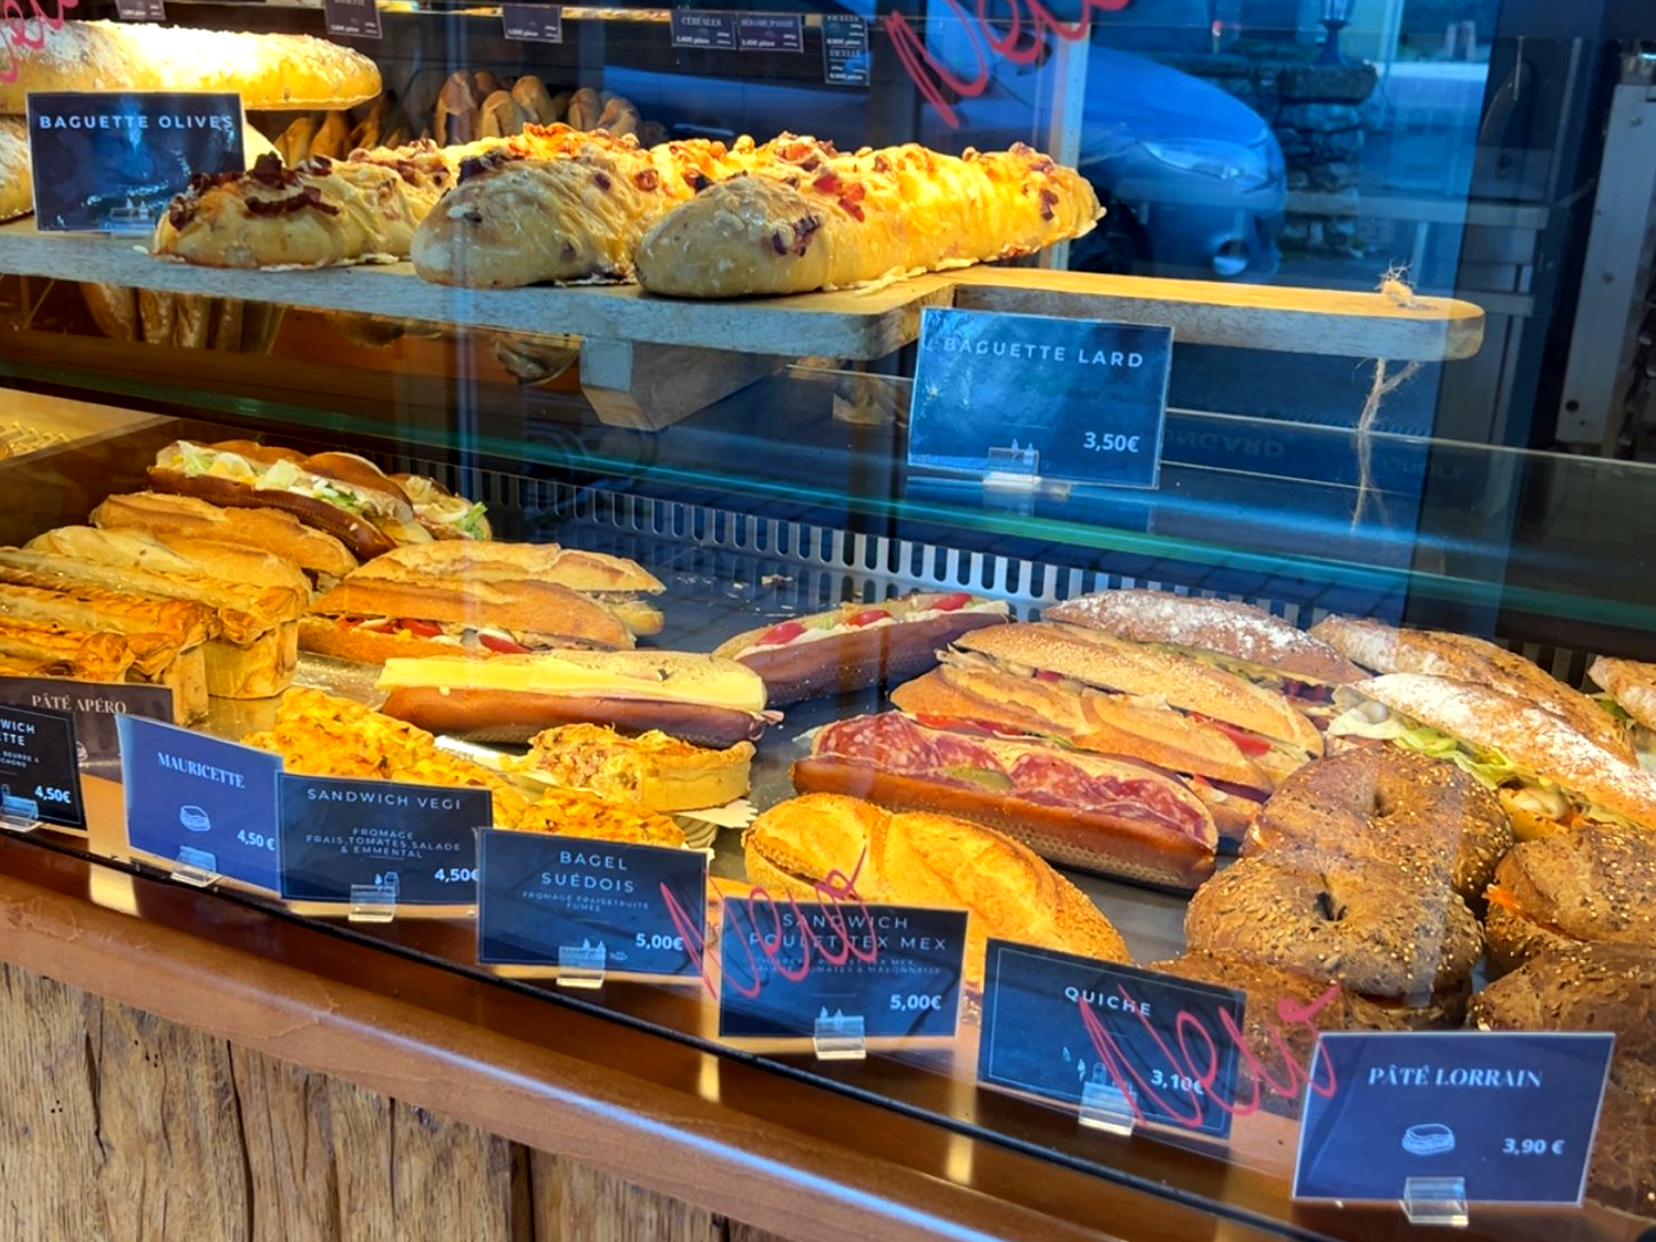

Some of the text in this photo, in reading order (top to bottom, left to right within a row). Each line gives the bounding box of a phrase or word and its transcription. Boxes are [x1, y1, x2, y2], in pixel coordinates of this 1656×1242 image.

[39, 114, 234, 129] BAGUETTE OLIVES
[943, 337, 1144, 368] BAGUETTE LARD
[1083, 431, 1140, 452] 3,50€
[31, 692, 127, 714] PÂTÉ APÉRO
[0, 731, 25, 746] TTE
[157, 751, 246, 789] MAURICETTE
[34, 785, 71, 804] 4,50€
[307, 788, 462, 810] SANDWICH VEGI
[237, 829, 275, 851] 4,50 €
[352, 828, 414, 841] FROMAGE
[353, 845, 424, 859] EMMENTAL
[559, 851, 628, 871] BAGEL
[541, 872, 635, 893] SUÉDOIS
[635, 933, 683, 951] 5,00€
[849, 934, 889, 949] TEX
[900, 937, 947, 951] MEX
[890, 994, 942, 1010] 5,00€
[1064, 986, 1151, 1017] QUICHE
[1368, 1063, 1543, 1088] PÂTÉ LORRAIN
[1502, 1137, 1565, 1156] 3,90 €
